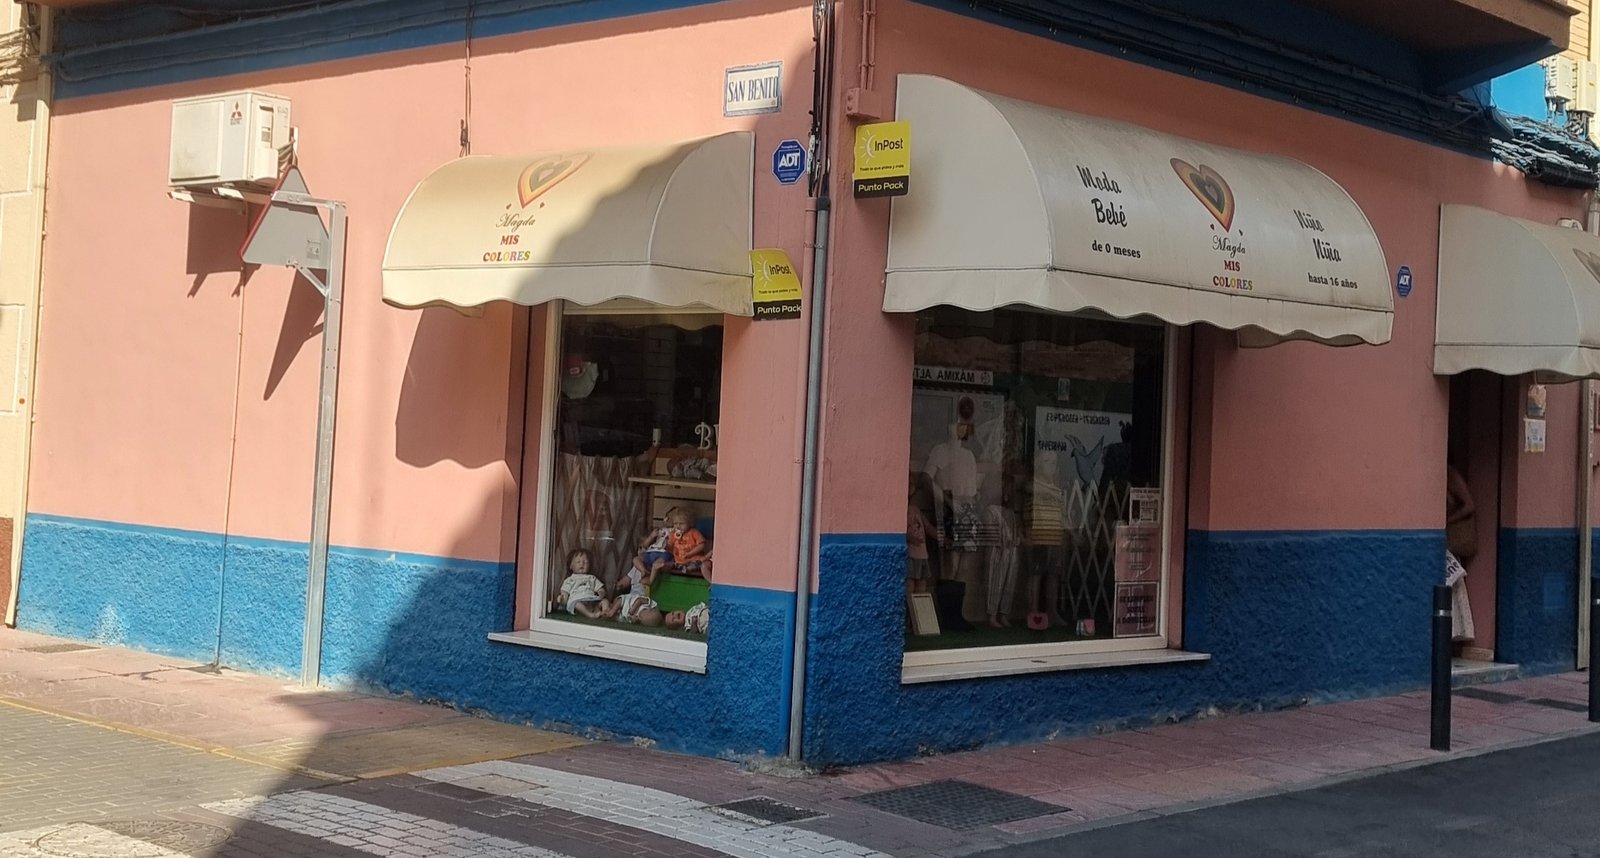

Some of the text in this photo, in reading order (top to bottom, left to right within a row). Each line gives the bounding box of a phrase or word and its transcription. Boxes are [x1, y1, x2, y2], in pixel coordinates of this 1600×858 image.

[728, 76, 779, 103] SAN BENITO
[874, 138, 904, 152] InPost
[779, 152, 800, 168] ADT
[857, 181, 905, 193] Punto Pack
[1076, 165, 1122, 194] Moda
[1091, 198, 1128, 228] Bebé
[1293, 209, 1324, 232] Niño
[495, 213, 536, 233] Magda
[500, 235, 520, 246] MIS
[1212, 235, 1246, 258] Magda
[483, 251, 531, 262] COLORES
[1092, 240, 1141, 259] de 0 meses
[1312, 238, 1342, 263] Niña
[1224, 260, 1240, 272] MIS
[1212, 276, 1253, 291] COLORES
[1308, 272, 1358, 290] hasta 16 años
[1399, 274, 1411, 286] ADT
[757, 304, 802, 314] Punto Pack
